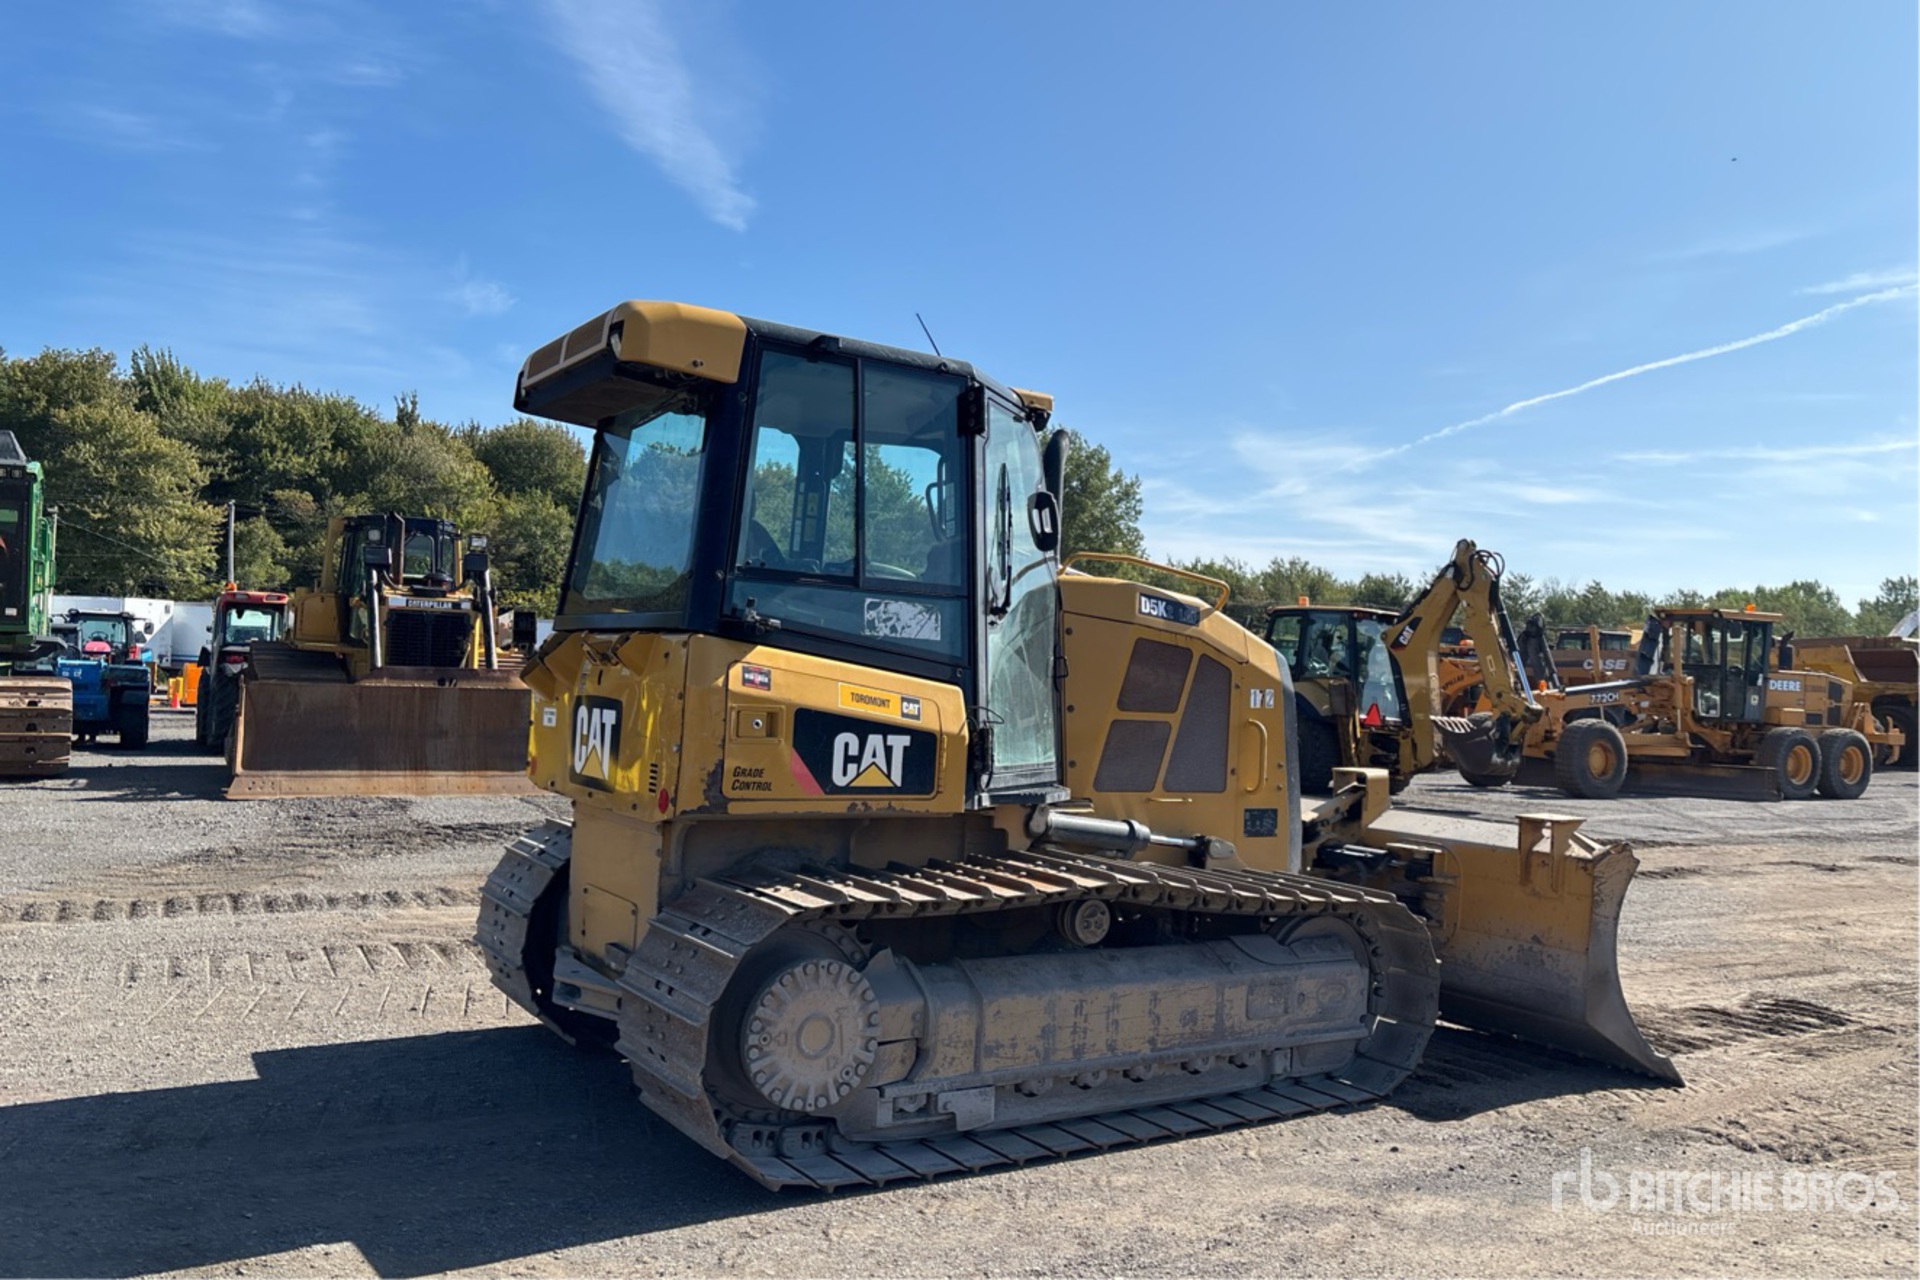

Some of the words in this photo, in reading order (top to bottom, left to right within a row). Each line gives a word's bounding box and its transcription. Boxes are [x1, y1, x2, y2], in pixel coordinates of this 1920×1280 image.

[407, 599, 453, 609] CATERPILLAR
[1399, 624, 1415, 646] CAT
[1769, 680, 1801, 691] DEERE
[850, 691, 891, 709] TOROMONT
[902, 701, 919, 716] CAT
[574, 705, 617, 781] CAT
[831, 732, 911, 787] CAT
[733, 766, 766, 778] GRADE
[731, 779, 773, 792] CONTROL
